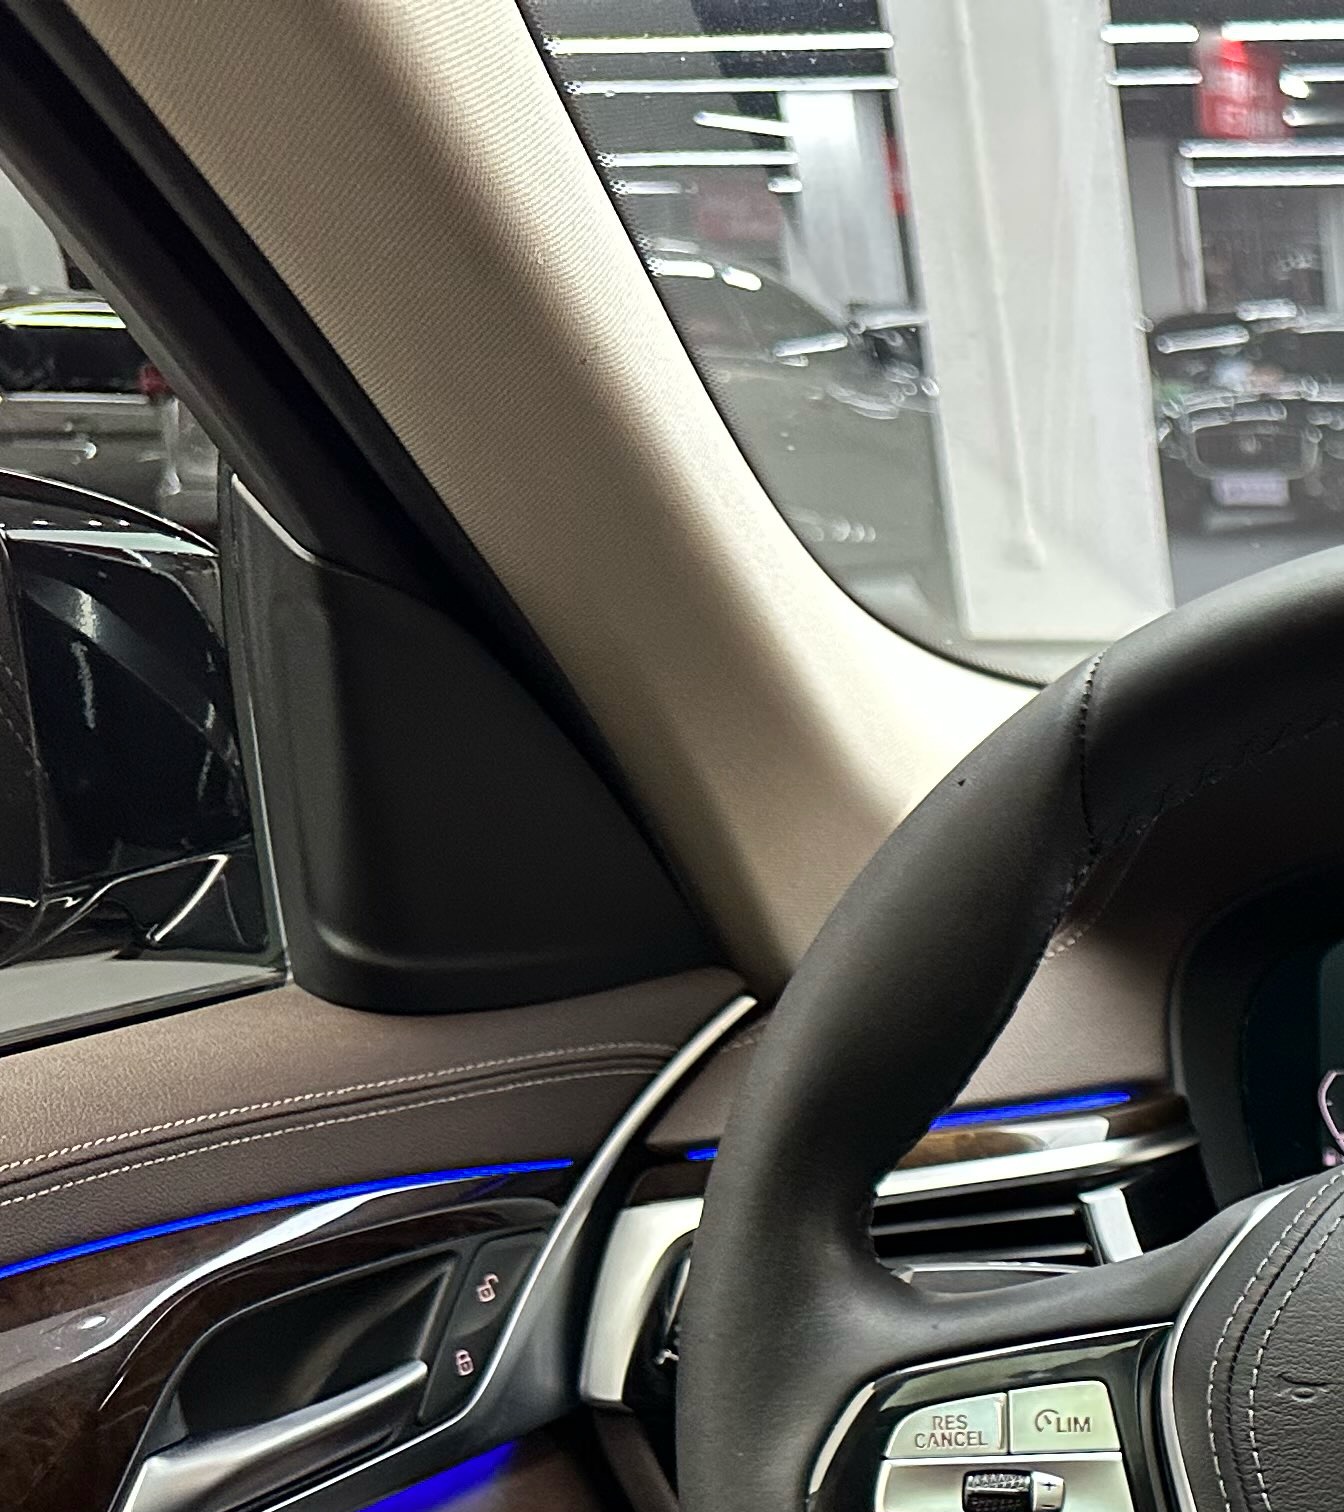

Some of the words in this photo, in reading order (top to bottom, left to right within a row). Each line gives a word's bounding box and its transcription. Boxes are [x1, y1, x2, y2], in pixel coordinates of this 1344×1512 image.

[931, 1414, 968, 1431] RES
[1055, 1416, 1091, 1433] LIM
[914, 1431, 988, 1449] CANCEL
